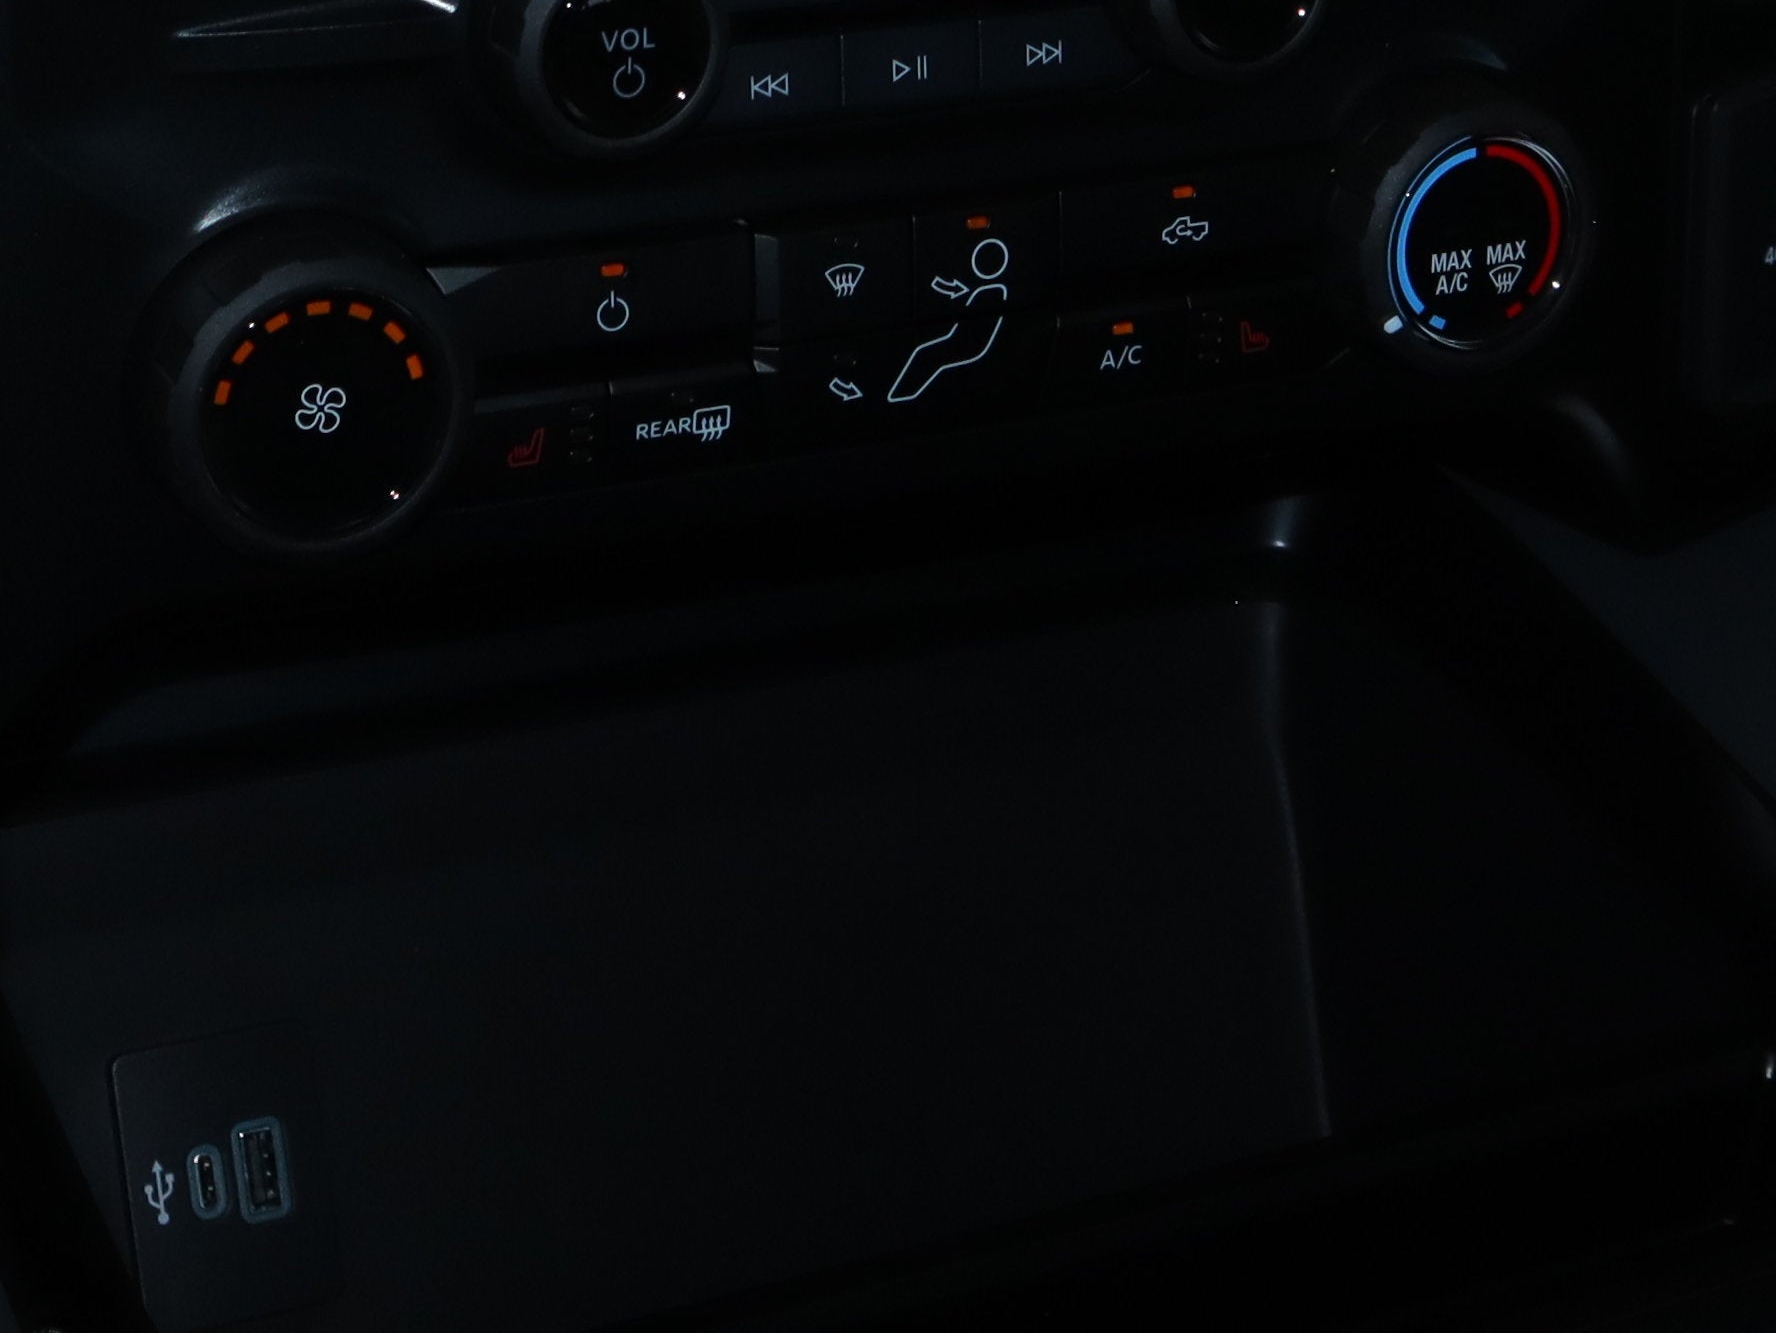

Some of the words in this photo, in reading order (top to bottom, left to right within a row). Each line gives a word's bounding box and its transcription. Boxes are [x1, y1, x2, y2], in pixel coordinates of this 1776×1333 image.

[601, 27, 656, 52] VOL
[1431, 249, 1472, 274] MAX
[1486, 240, 1527, 265] MAX
[1435, 271, 1468, 295] A/C
[1100, 342, 1143, 371] A/C
[636, 414, 692, 439] REAR
